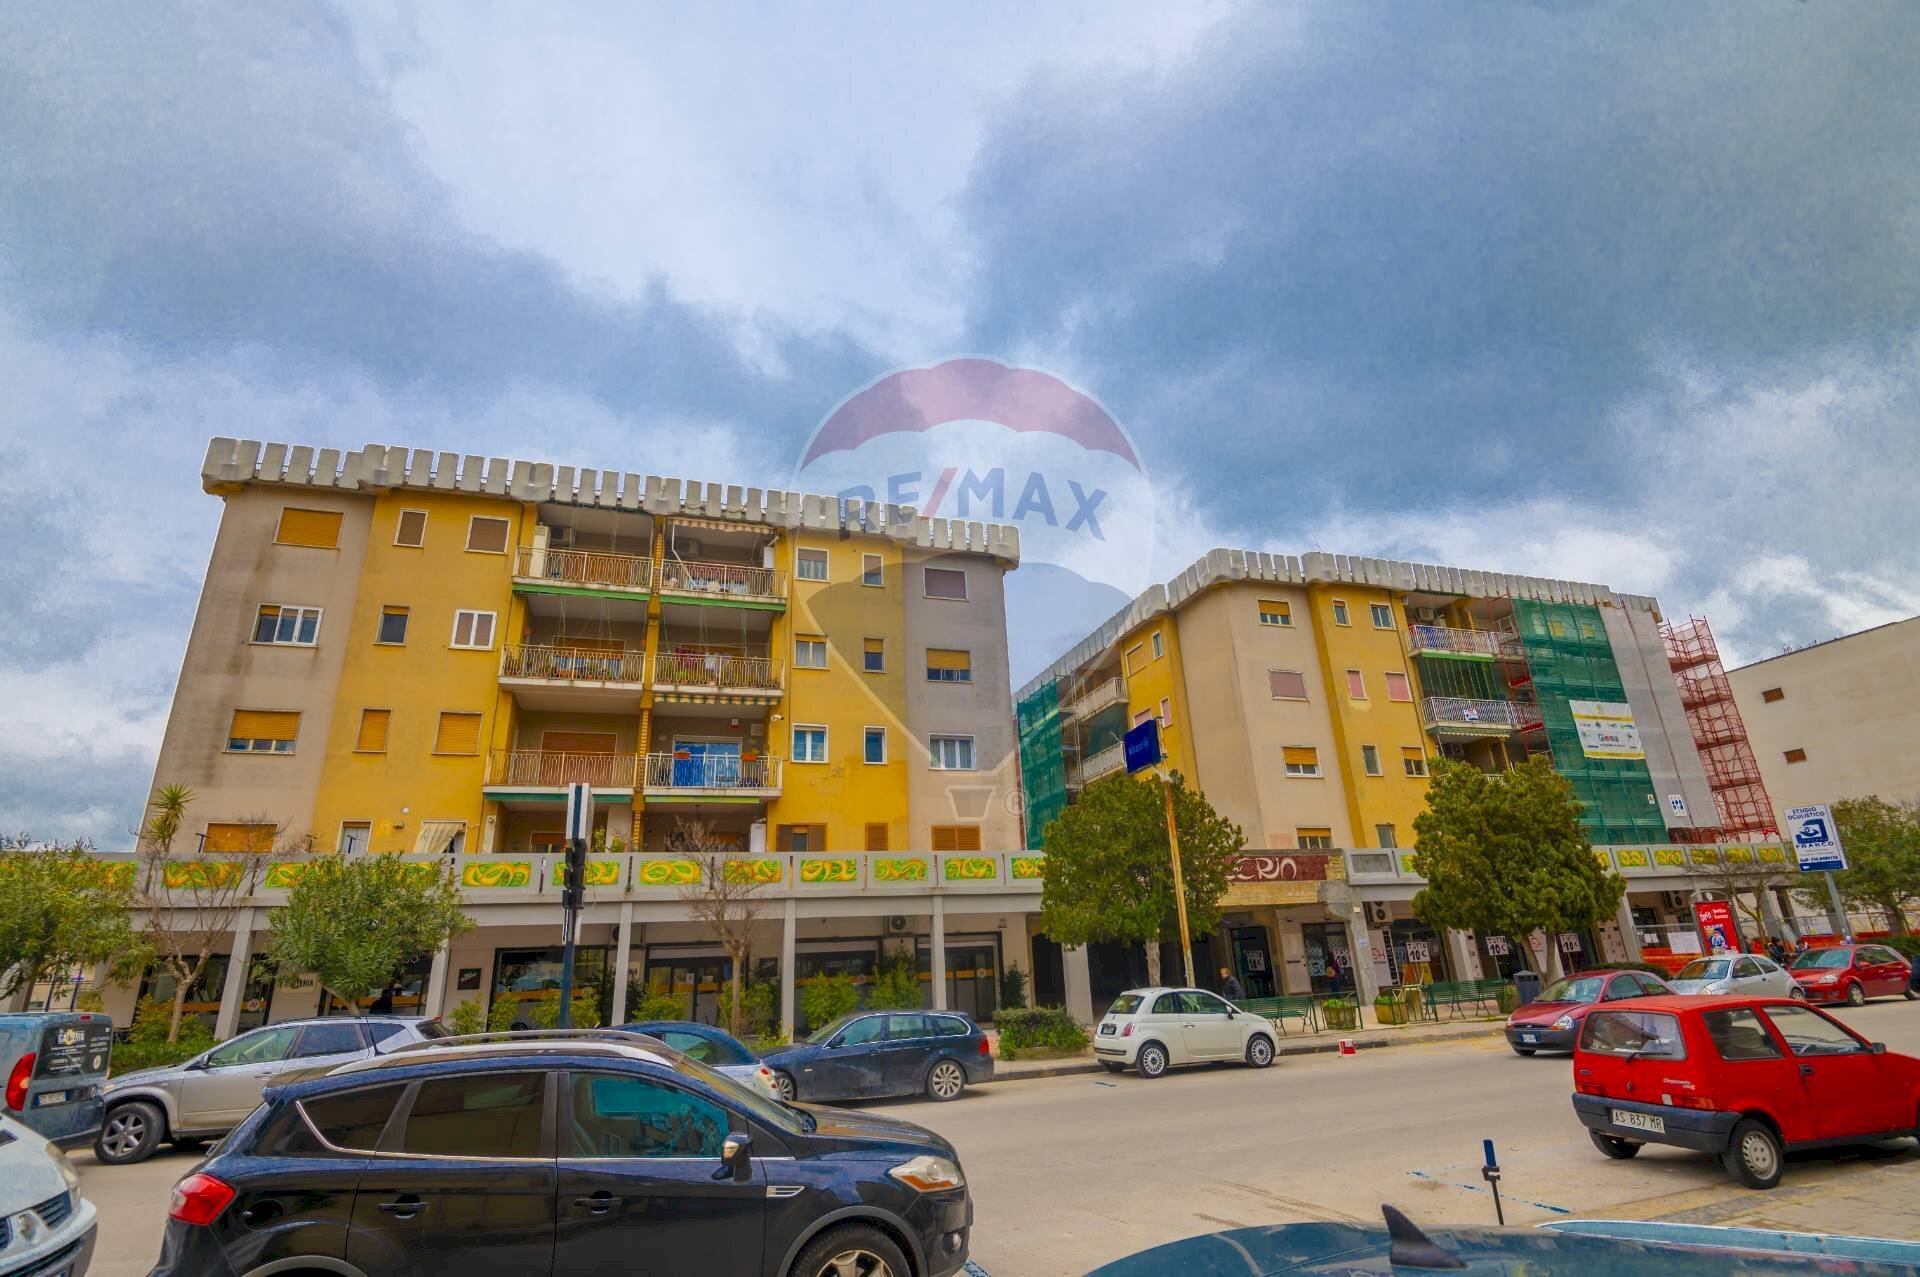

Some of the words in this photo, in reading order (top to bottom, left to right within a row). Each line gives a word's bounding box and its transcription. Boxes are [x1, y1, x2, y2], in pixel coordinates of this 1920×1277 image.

[1792, 806, 1817, 814] STUDIO
[1787, 811, 1825, 820] OCULISTICO
[1796, 841, 1834, 849] FRANCO
[1407, 942, 1427, 950] TUTTO
[1615, 1111, 1625, 1123] AS
[1630, 1114, 1646, 1126] 837
[1650, 1116, 1662, 1129] MR
